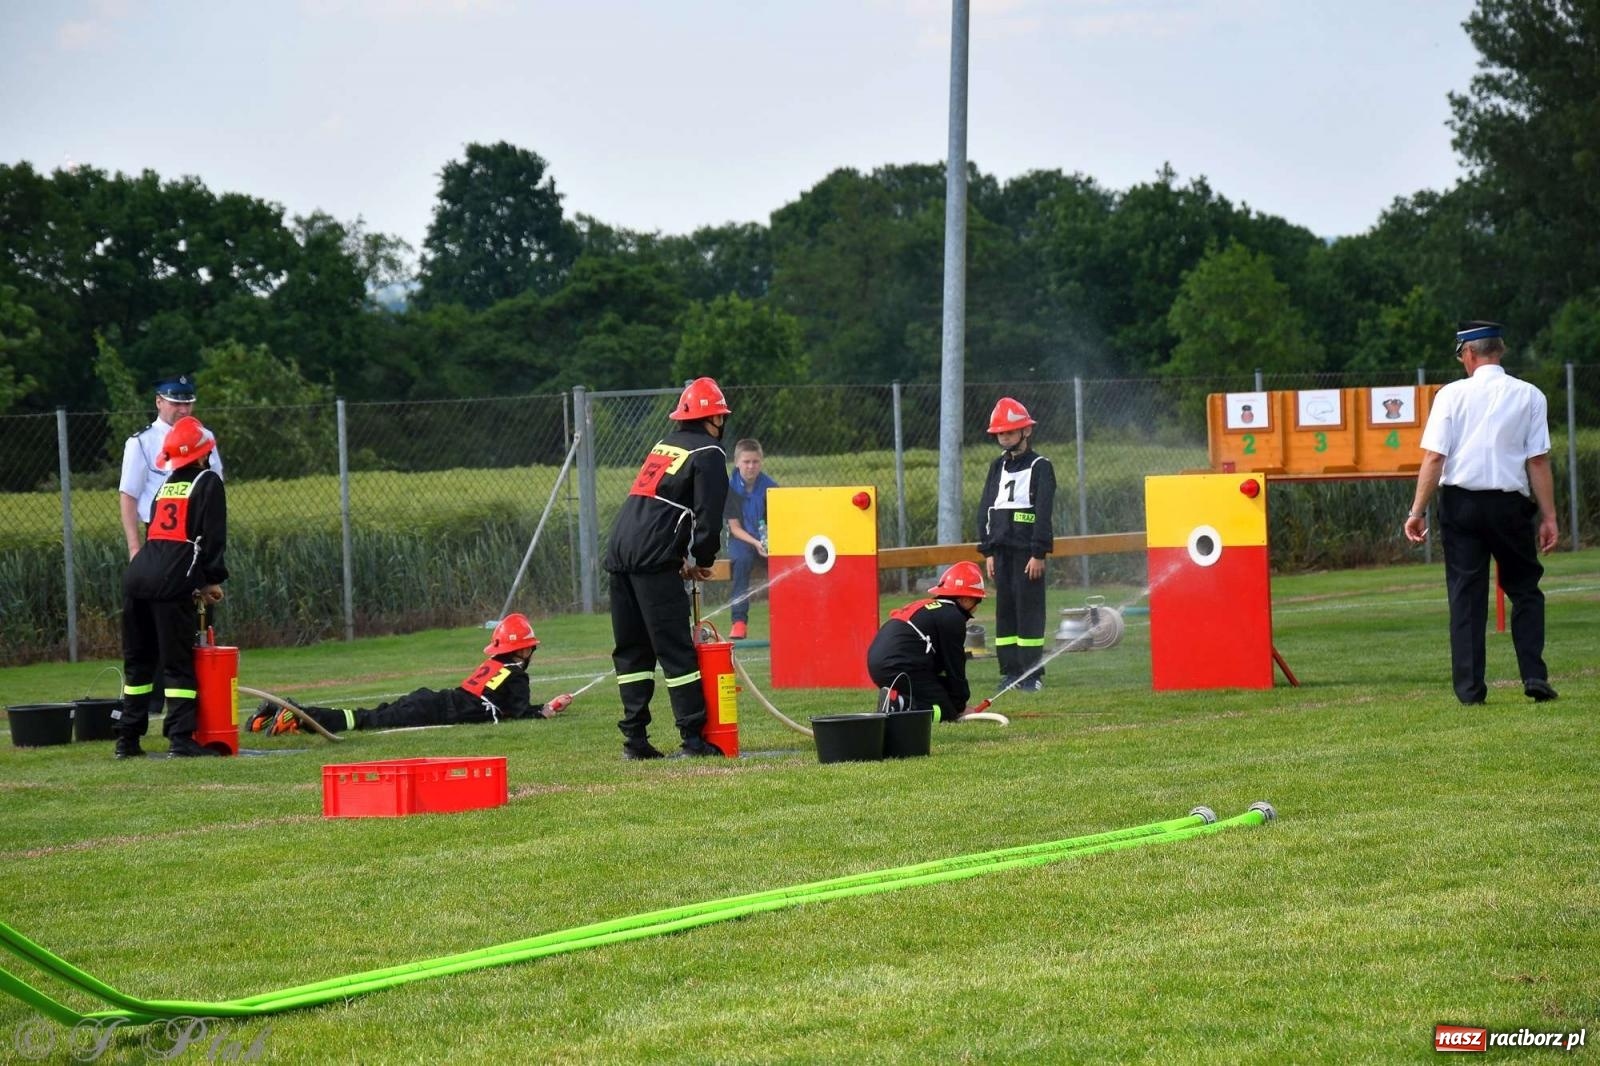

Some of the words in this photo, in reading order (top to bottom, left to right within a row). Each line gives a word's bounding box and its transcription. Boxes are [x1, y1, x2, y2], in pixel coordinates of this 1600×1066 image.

[1241, 433, 1256, 454] 2
[1314, 432, 1328, 452] 3
[1384, 429, 1400, 449] 4
[1004, 480, 1015, 502] 1
[160, 503, 178, 530] 3
[468, 666, 490, 685] 2
